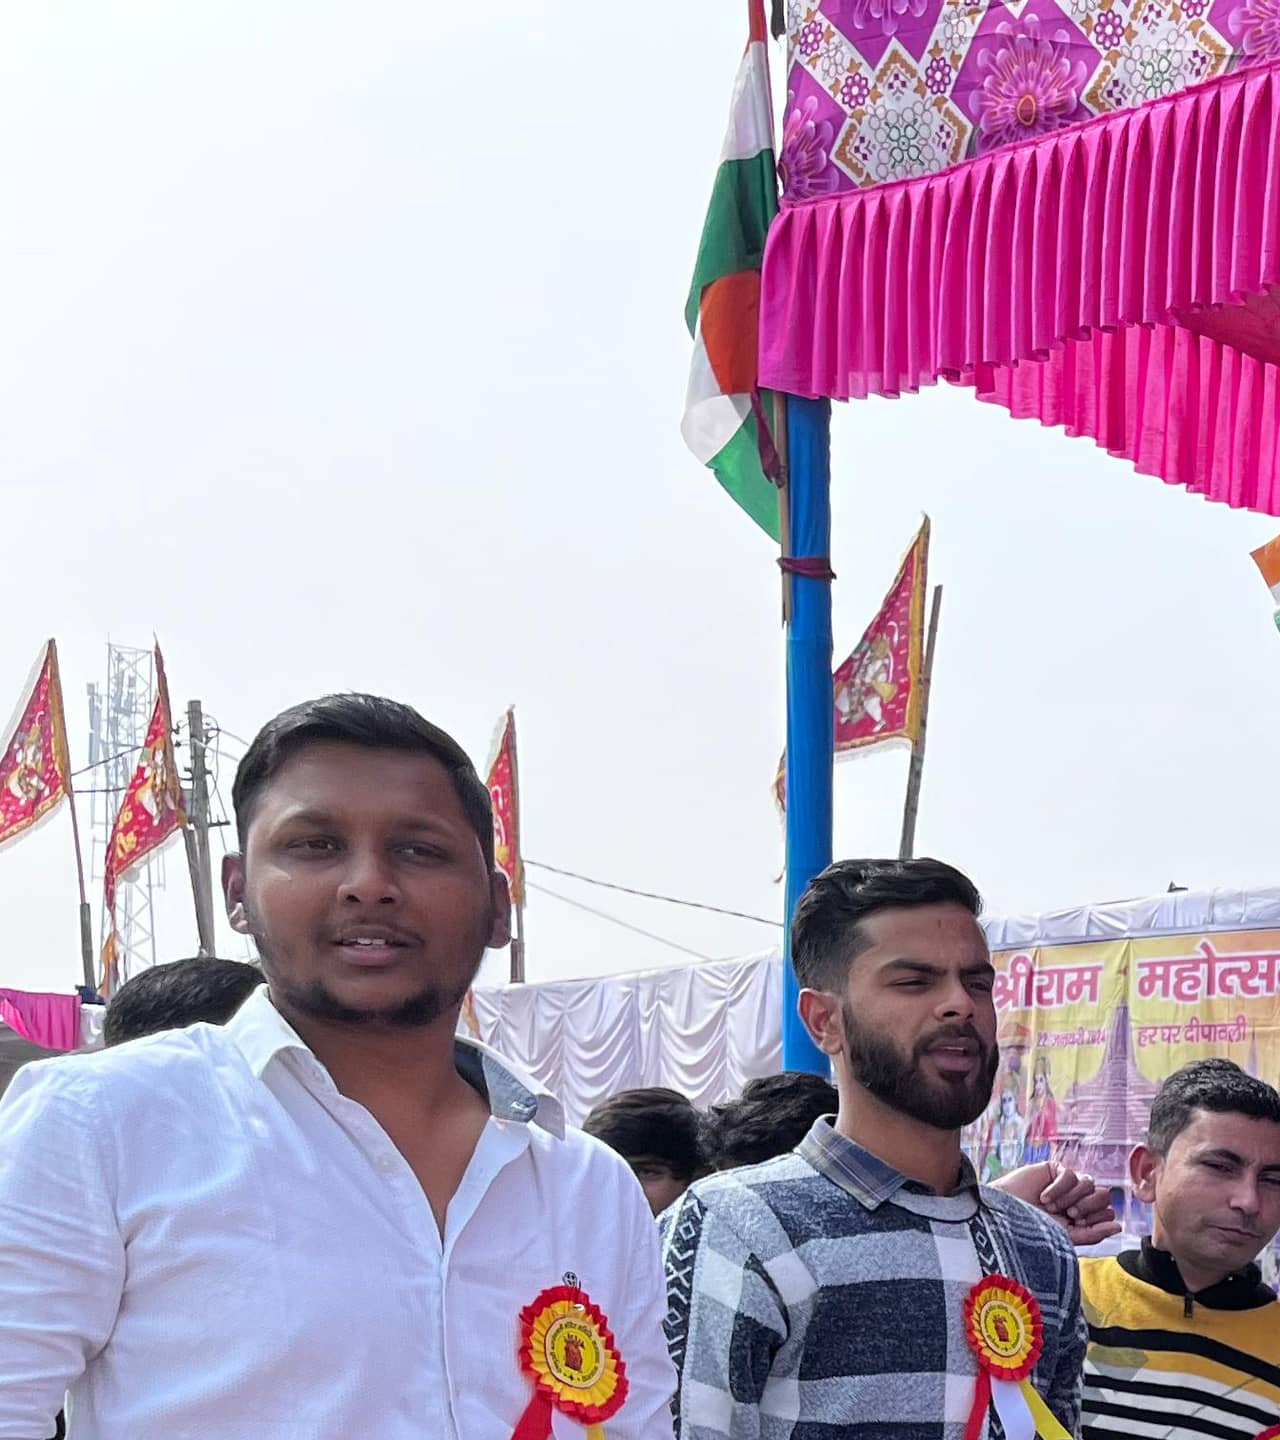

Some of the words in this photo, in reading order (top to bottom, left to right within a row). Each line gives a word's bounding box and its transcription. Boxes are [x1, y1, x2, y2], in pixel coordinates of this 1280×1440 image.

[1138, 1026, 1158, 1047] हर
[1161, 1024, 1181, 1044] घर
[1185, 1014, 1247, 1043] दीपावली
